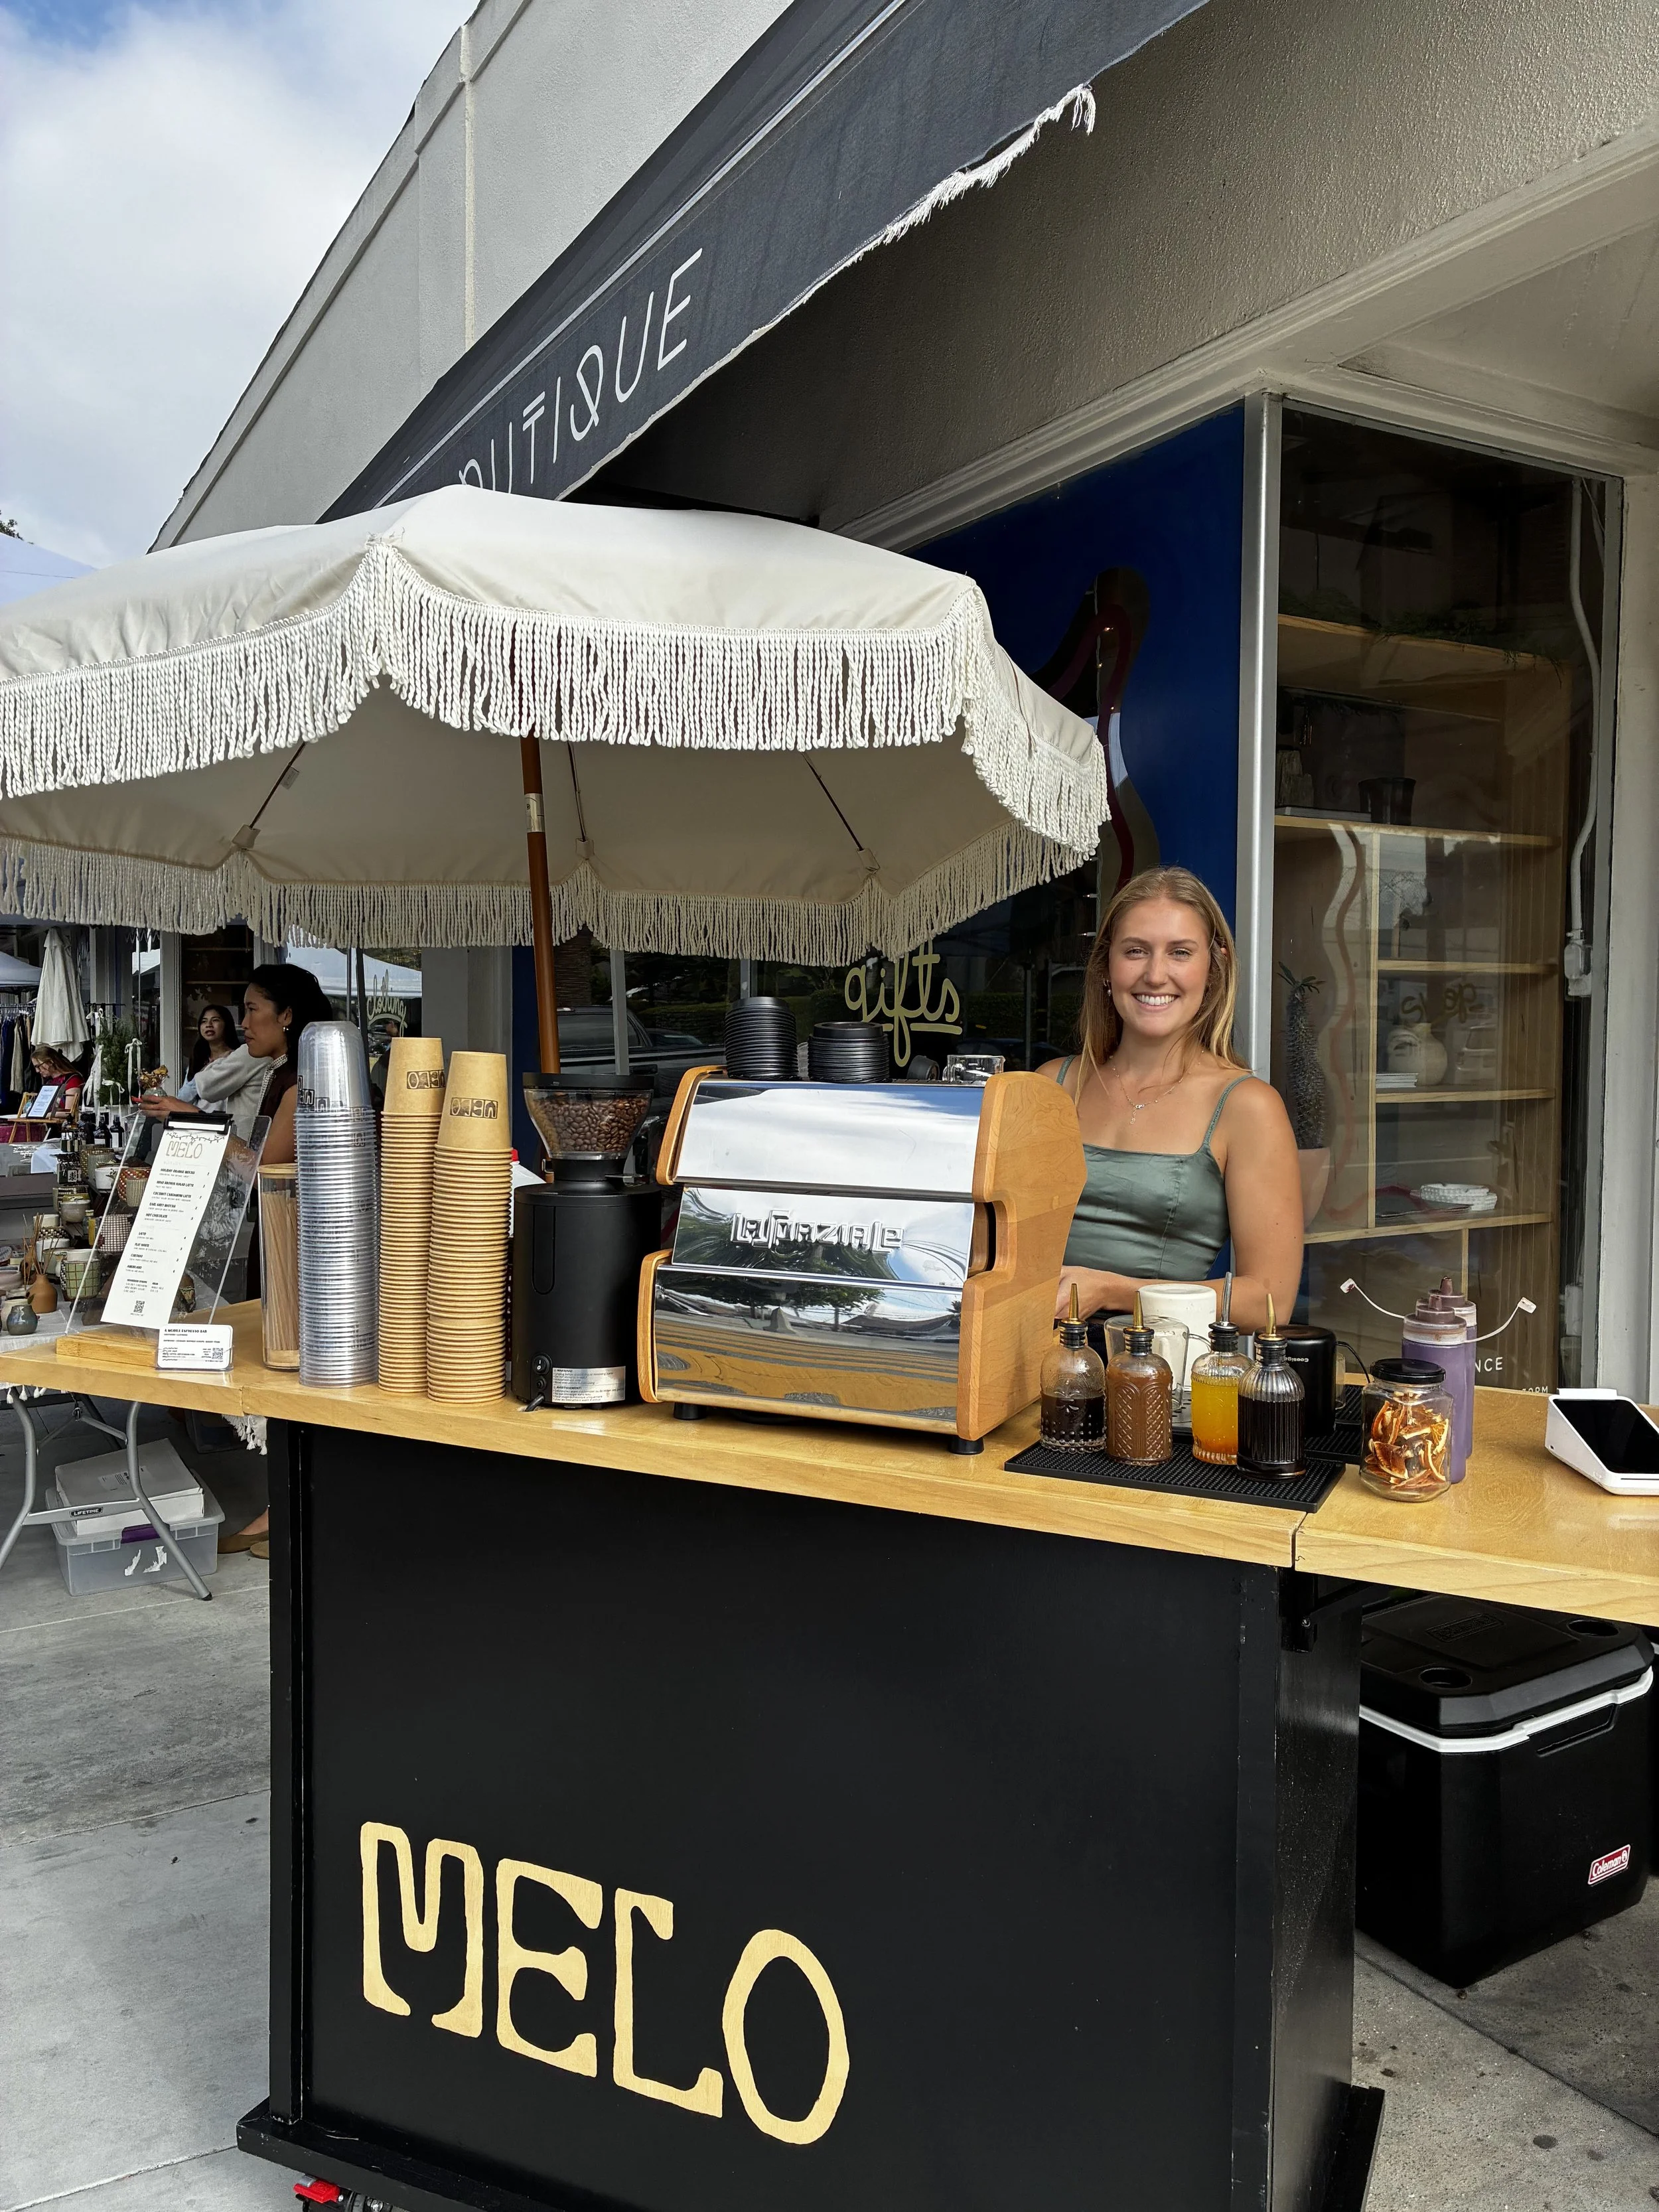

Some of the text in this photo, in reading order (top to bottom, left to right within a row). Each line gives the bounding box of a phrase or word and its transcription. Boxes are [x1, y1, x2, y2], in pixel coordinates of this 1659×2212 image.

[845, 938, 960, 1067] gifts
[166, 1141, 202, 1159] MELO
[1593, 1855, 1622, 1878] Coleman
[360, 1822, 849, 2144] MELO
